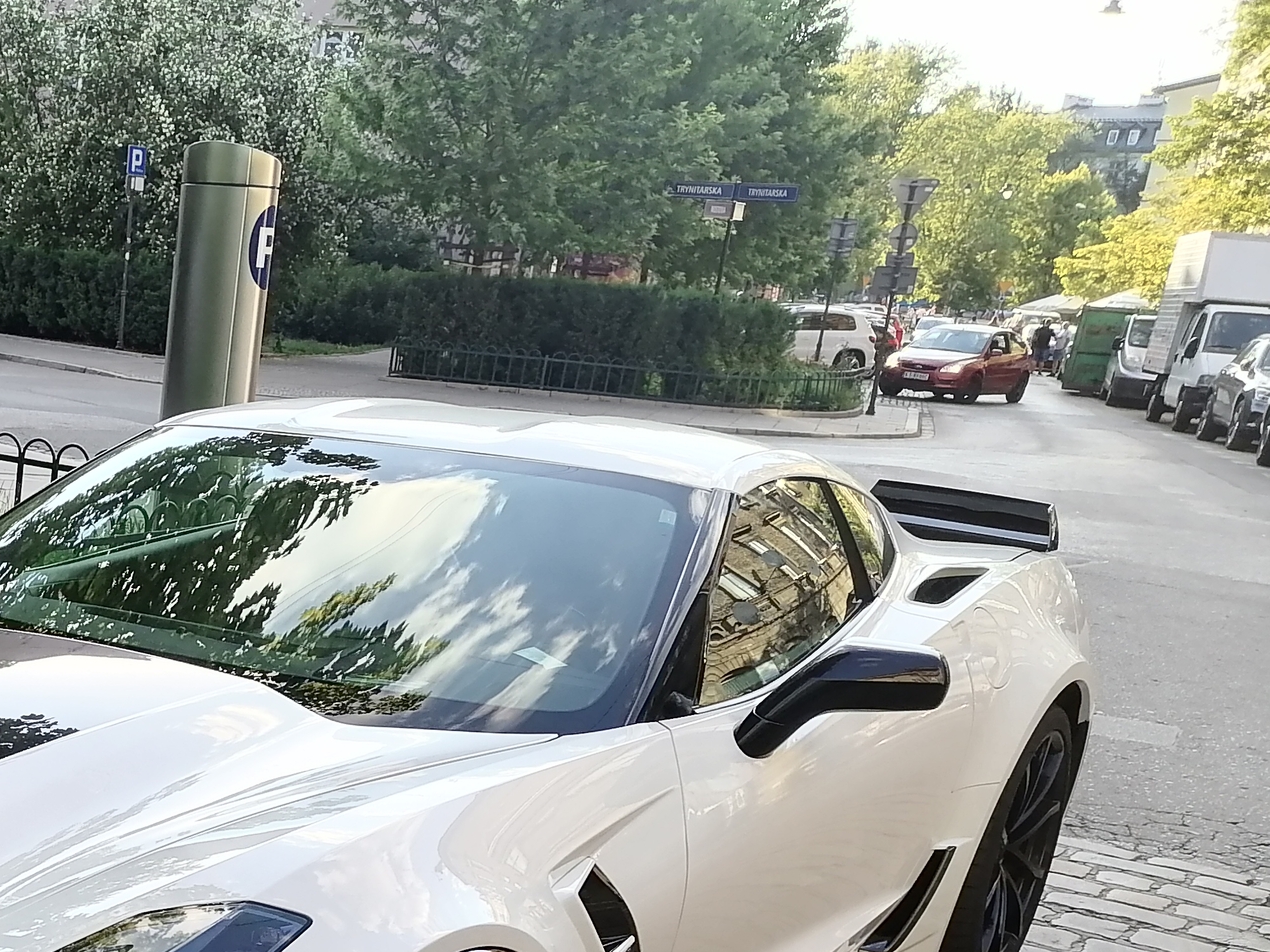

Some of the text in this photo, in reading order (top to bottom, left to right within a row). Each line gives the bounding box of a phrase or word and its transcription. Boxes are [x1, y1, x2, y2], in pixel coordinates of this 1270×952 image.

[132, 149, 143, 172] P
[676, 185, 723, 195] TRYNITARSKA
[748, 188, 788, 198] TRYNITARSKA
[256, 226, 274, 268] P
